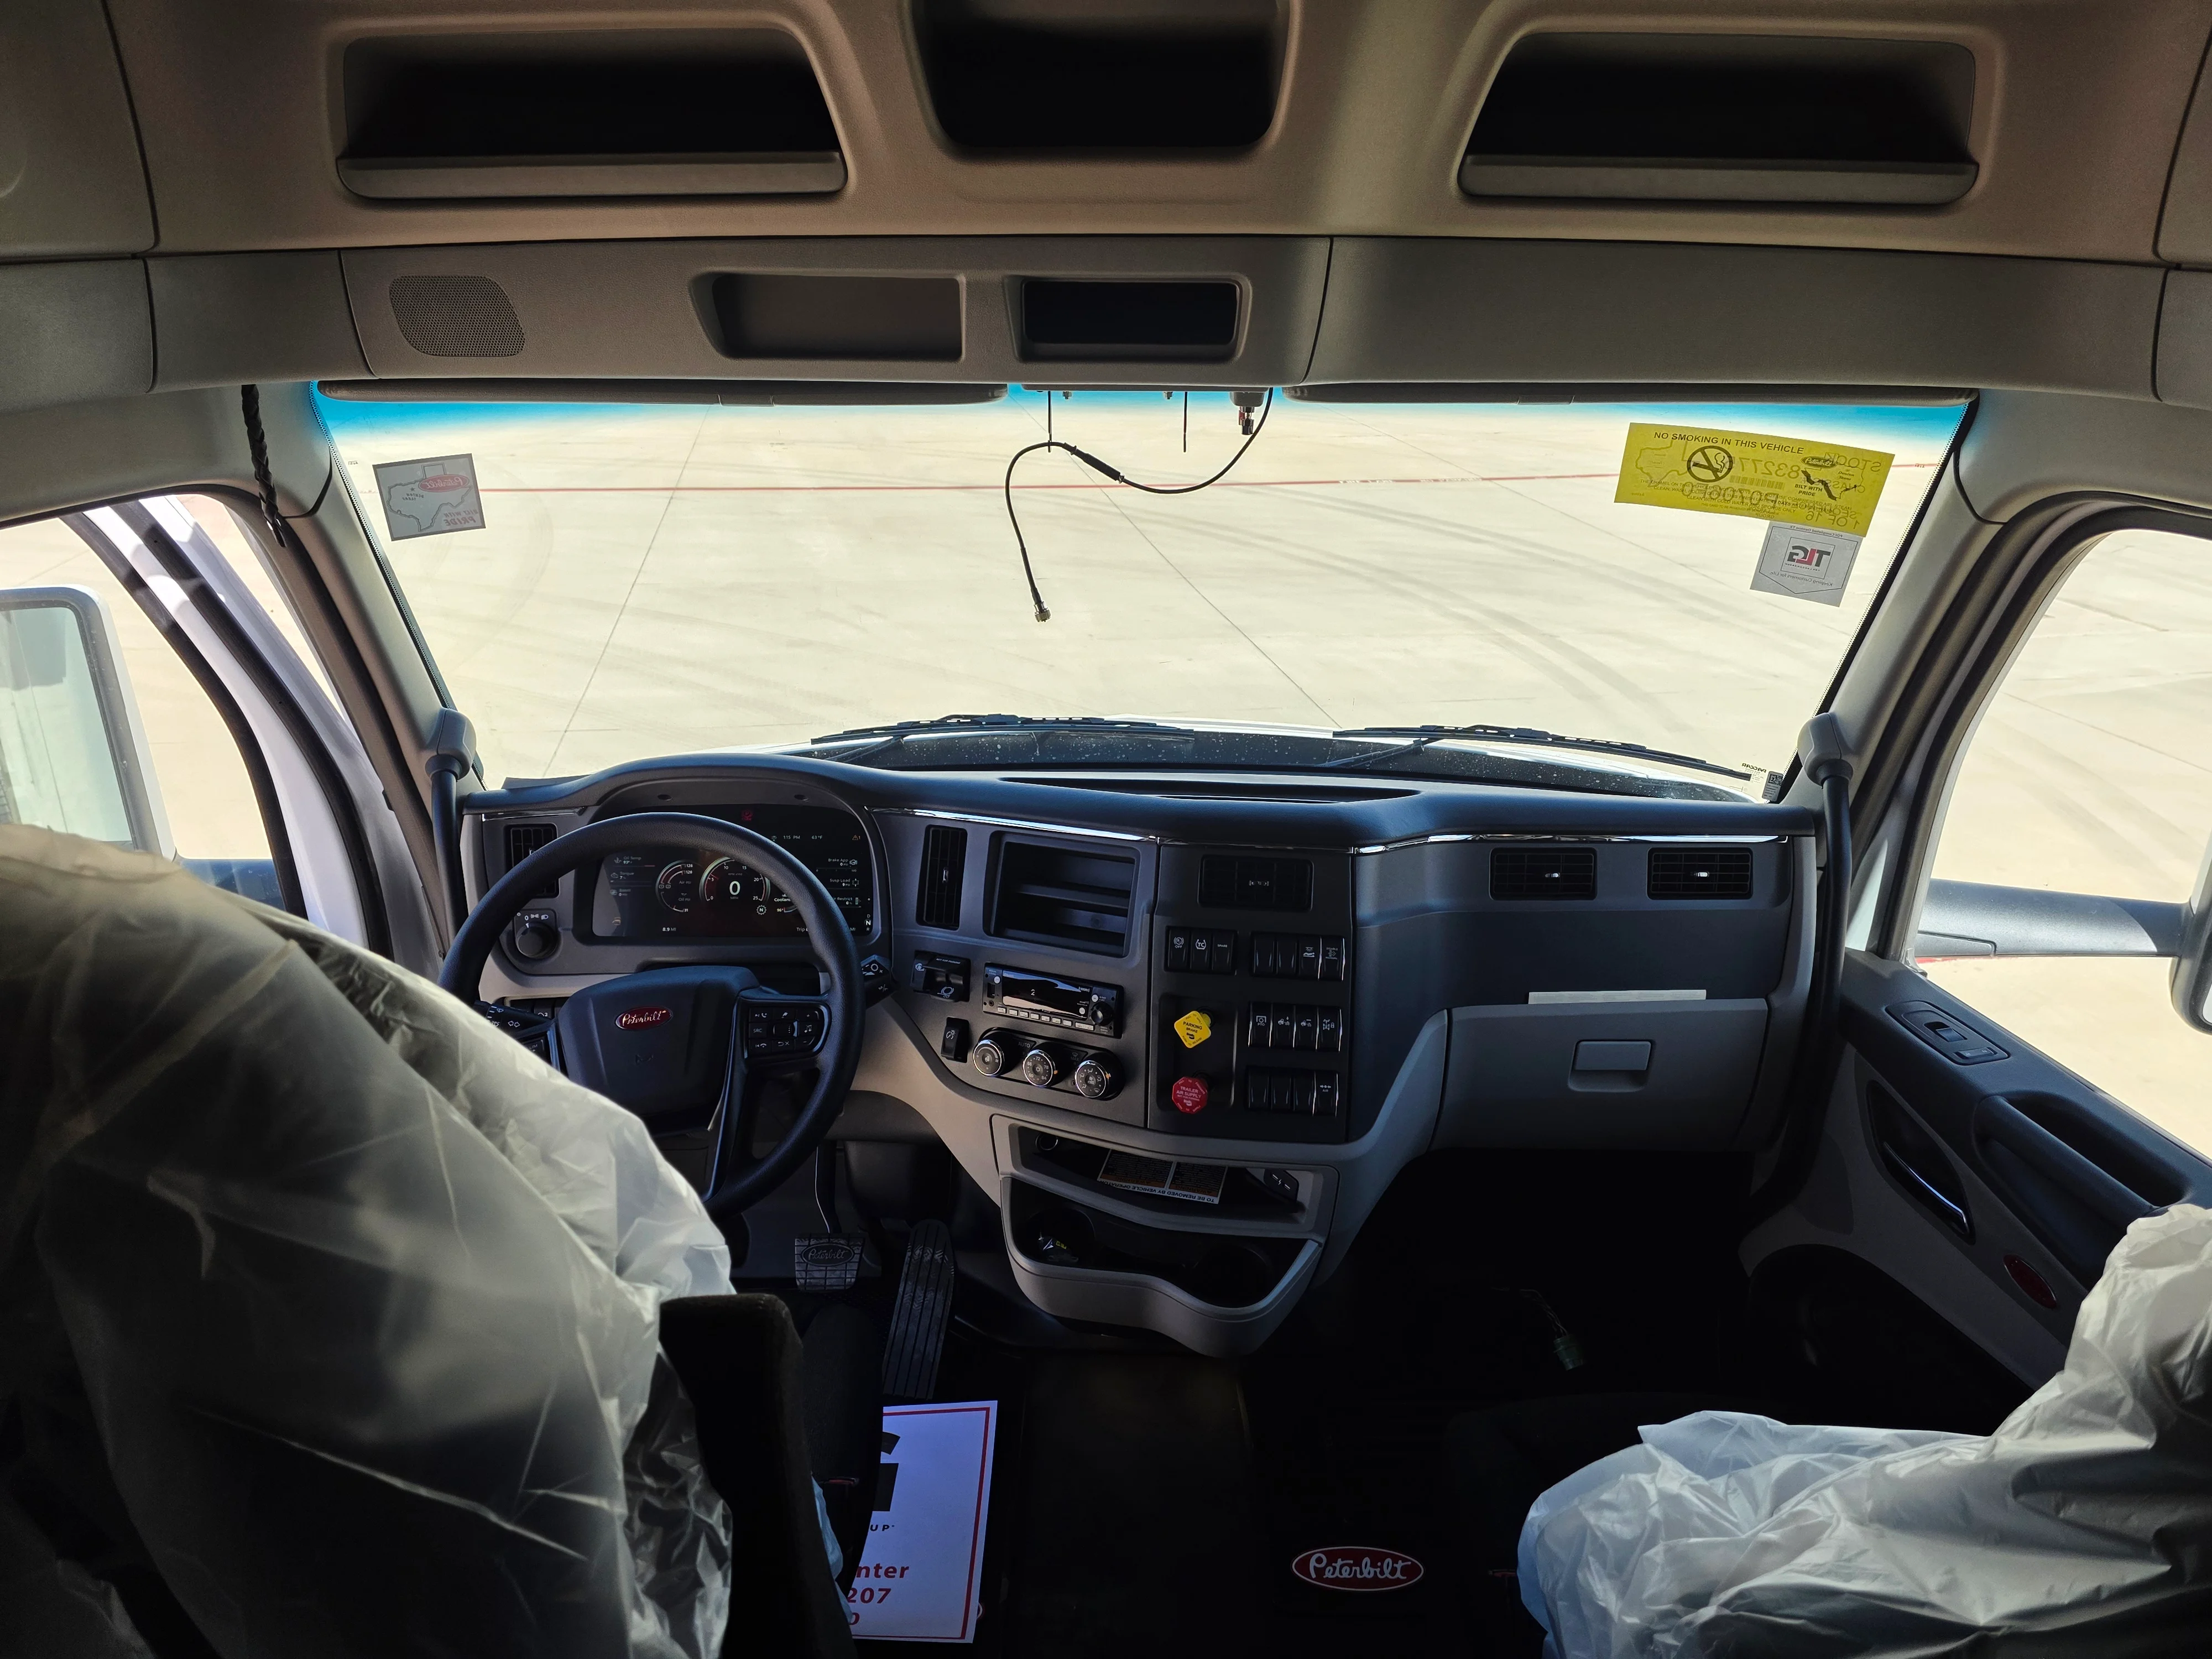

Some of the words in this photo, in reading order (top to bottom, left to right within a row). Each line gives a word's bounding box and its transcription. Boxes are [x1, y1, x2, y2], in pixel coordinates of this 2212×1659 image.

[1671, 433, 1719, 444] SMOKING
[1735, 439, 1757, 448] THIS
[1760, 442, 1804, 454] VEHICLE
[729, 880, 740, 895] 0
[622, 1010, 666, 1026] Peterbilt
[1183, 1021, 1203, 1030] PARKING
[1167, 1190, 1196, 1199] REMOVED
[808, 1249, 846, 1260] Peterbilt
[1309, 1553, 1412, 1579] Peterbilt
